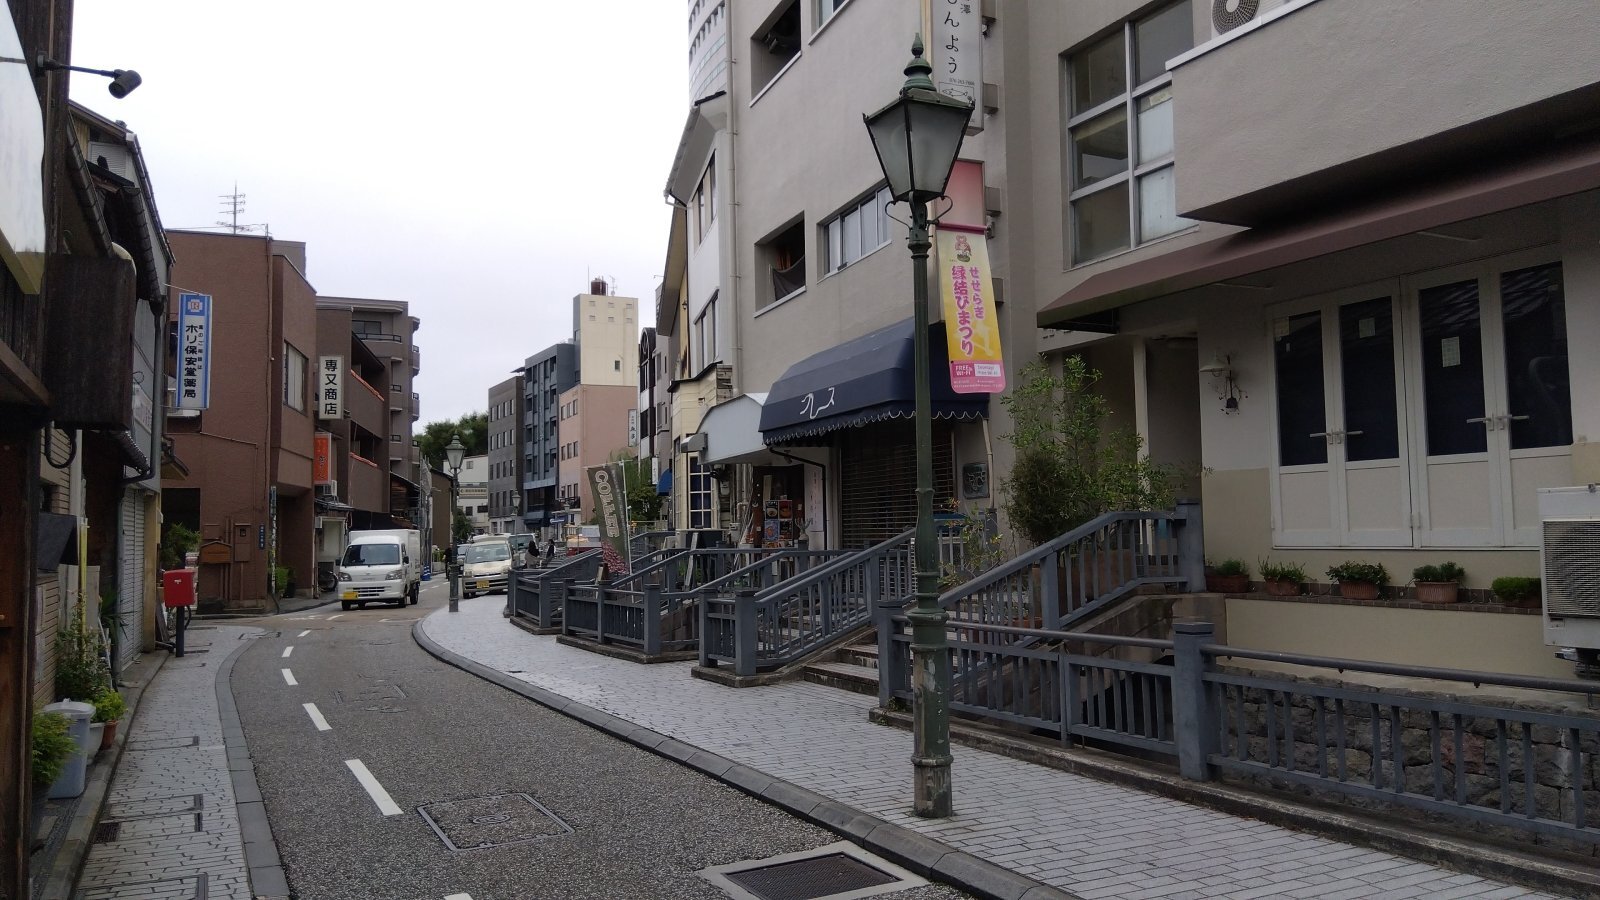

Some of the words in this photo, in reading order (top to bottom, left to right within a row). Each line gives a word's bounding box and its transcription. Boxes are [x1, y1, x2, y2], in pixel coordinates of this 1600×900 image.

[951, 265, 975, 357] 縁結びまつり
[969, 266, 985, 319] せせらぎ
[183, 324, 199, 398] ホリ保安堂薬局
[324, 359, 338, 415] 専又商店
[594, 470, 620, 538] COFFEE
